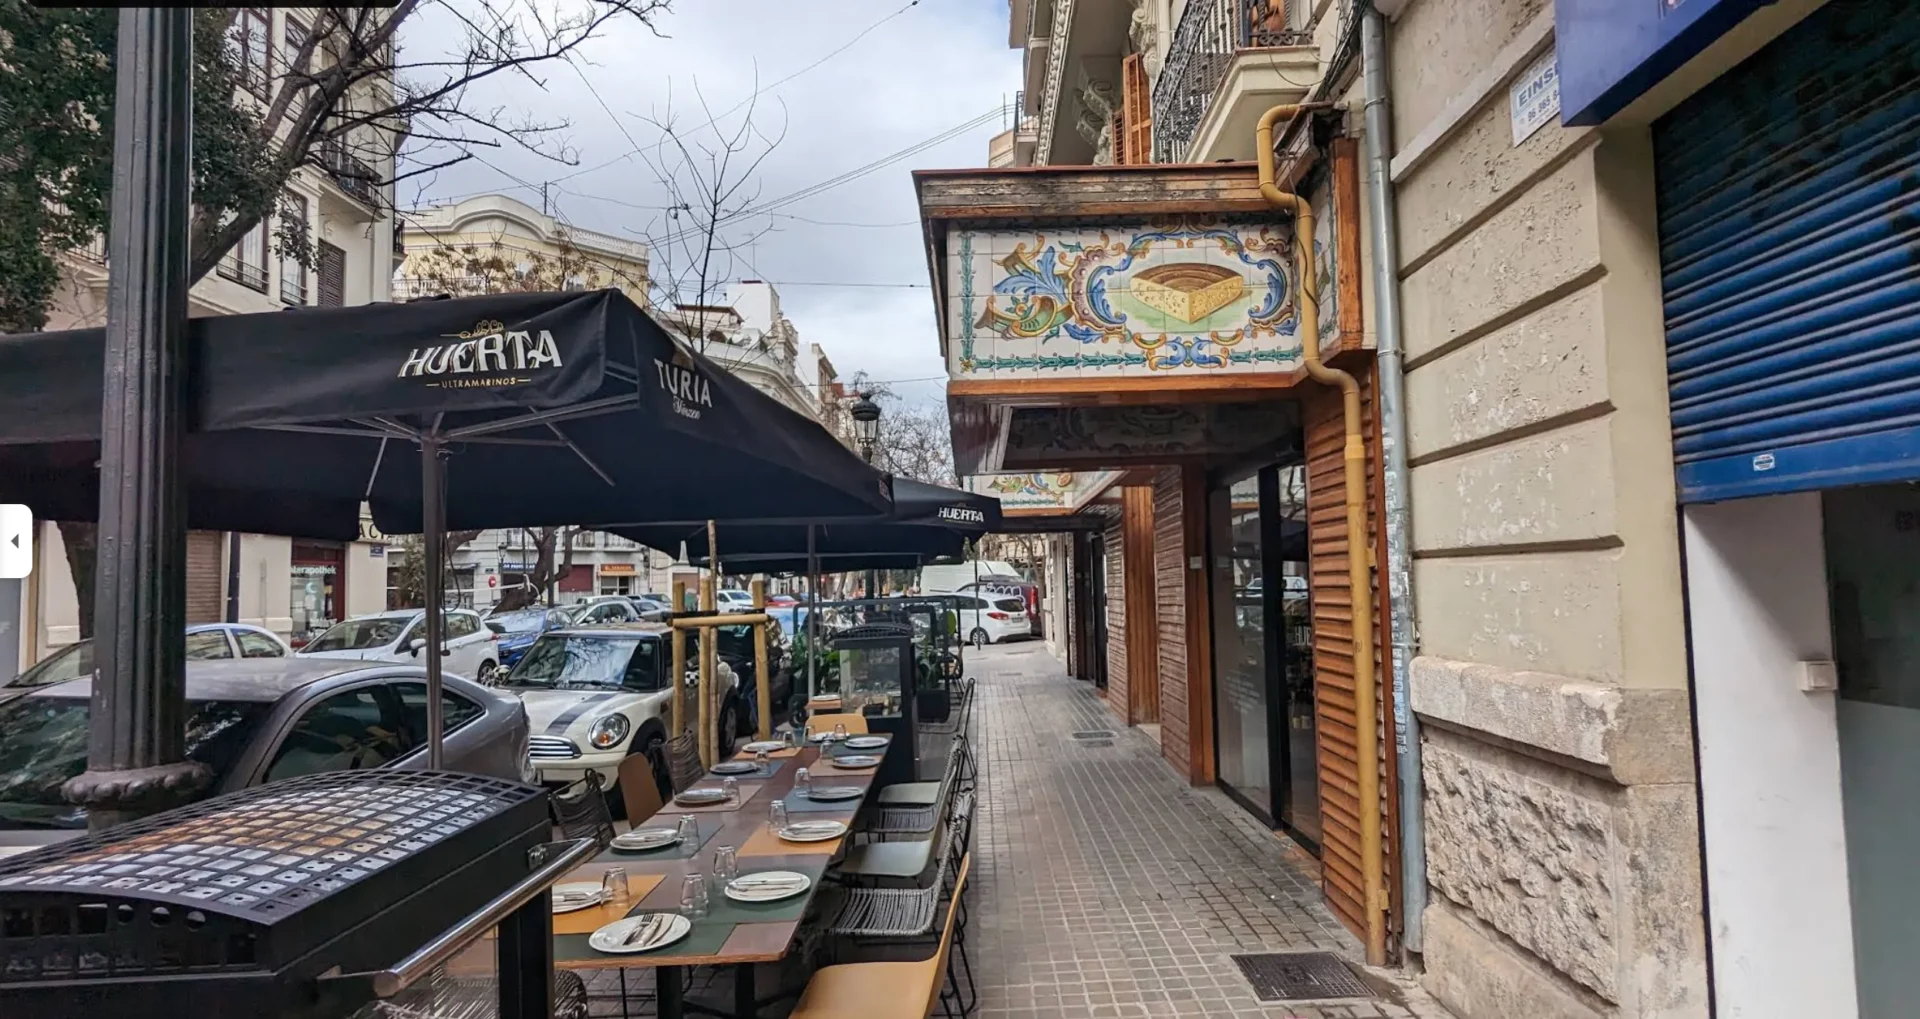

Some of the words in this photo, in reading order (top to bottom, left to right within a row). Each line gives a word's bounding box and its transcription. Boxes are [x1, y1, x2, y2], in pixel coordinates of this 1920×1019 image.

[397, 330, 563, 378] HUERTA
[441, 377, 516, 389] ULTRAMARINOS
[653, 358, 713, 408] TURIA
[937, 506, 985, 523] HUERTA
